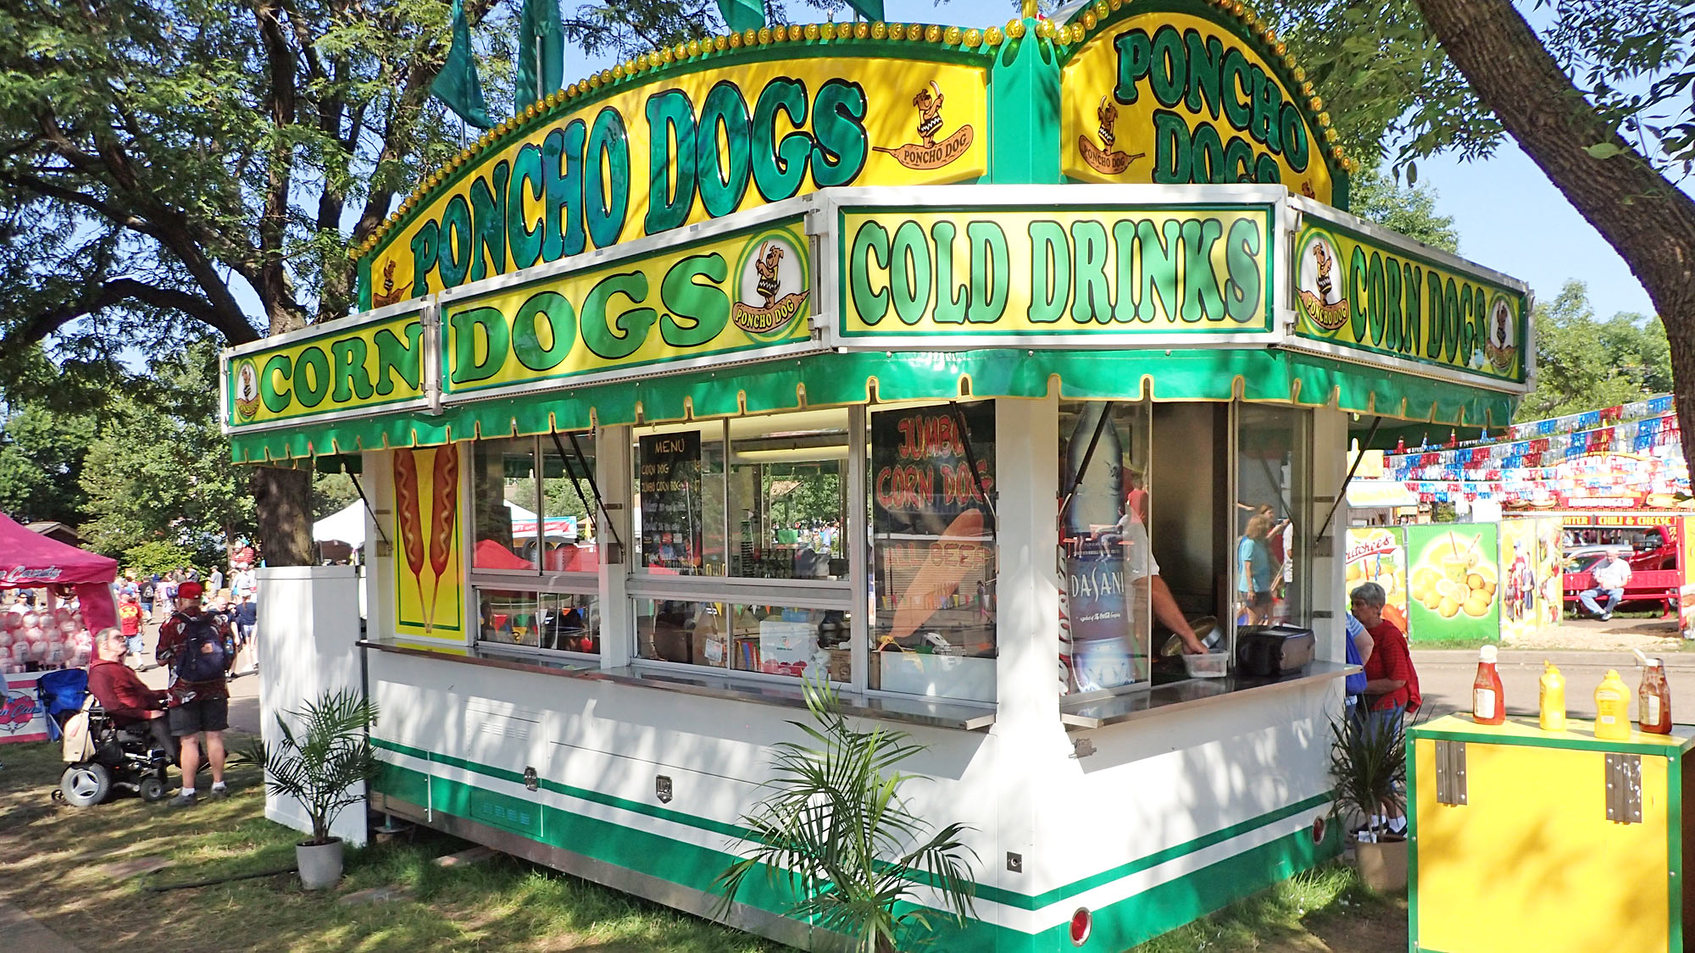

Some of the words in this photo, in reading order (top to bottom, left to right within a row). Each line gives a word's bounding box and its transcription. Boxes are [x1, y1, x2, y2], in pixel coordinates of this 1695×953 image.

[1114, 24, 1309, 173] PONCHO
[904, 147, 943, 164] PONCHO
[945, 133, 967, 158] DOG
[1083, 144, 1111, 168] PONCHO
[1111, 156, 1126, 168] DOG
[411, 106, 630, 298] PONCHO
[644, 77, 868, 236] DOGS
[850, 219, 1010, 325] COLD
[1027, 217, 1260, 324] DRINKS
[735, 308, 773, 329] PONCHO
[774, 298, 794, 324] DOG
[1306, 296, 1333, 325] PONCHO
[1350, 245, 1422, 355] CORN
[1427, 270, 1487, 370] DOGS
[261, 321, 424, 413] CORN
[450, 252, 729, 384] DOGS
[655, 439, 685, 454] MENU
[898, 411, 971, 460] JUMBO
[876, 464, 934, 510] CORN
[7, 565, 62, 582] Candy
[884, 543, 927, 568] ALL
[929, 543, 990, 569] BEEF
[1071, 567, 1124, 602] DASANI
